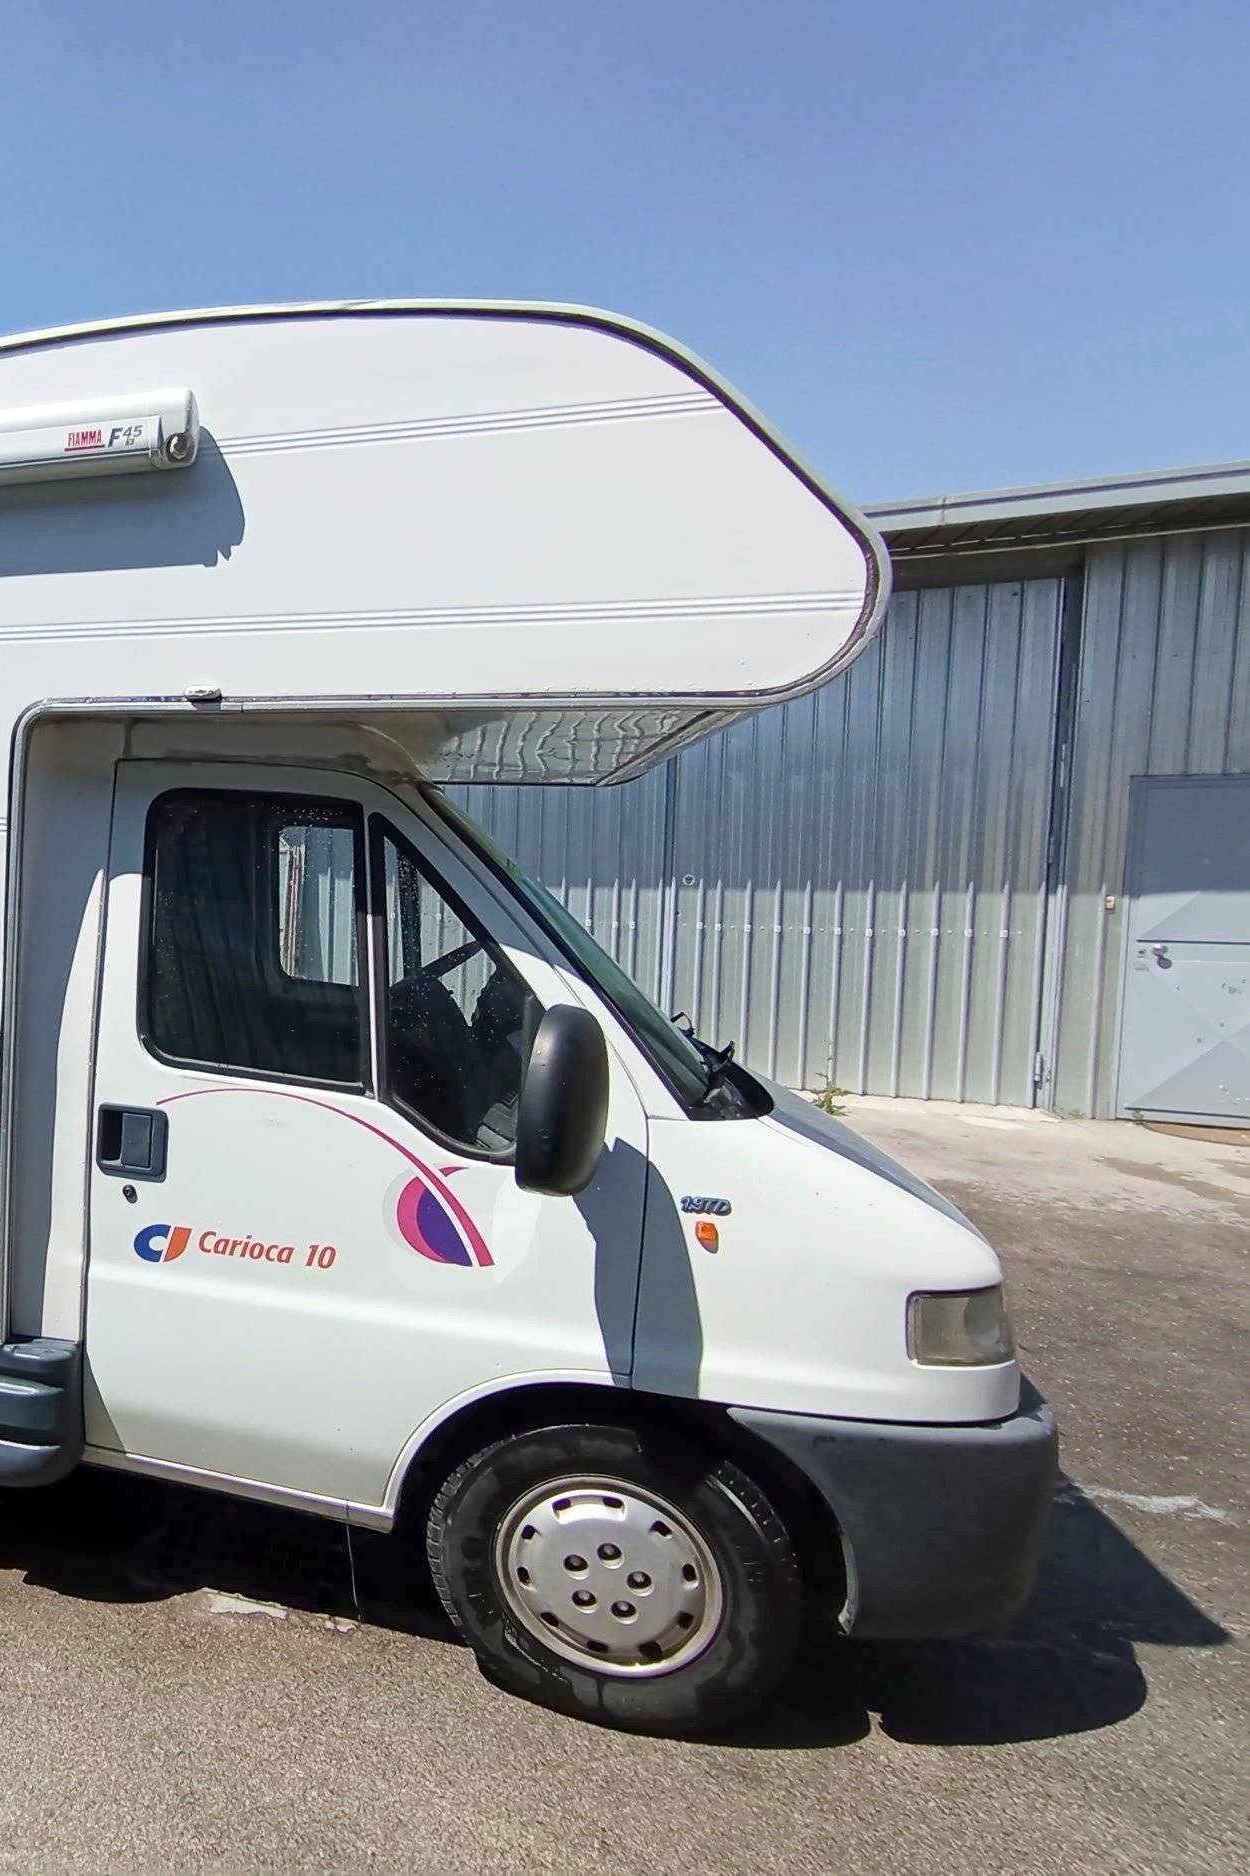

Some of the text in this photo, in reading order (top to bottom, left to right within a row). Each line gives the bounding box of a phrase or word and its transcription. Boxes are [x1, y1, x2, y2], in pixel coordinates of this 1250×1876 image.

[67, 430, 102, 447] FIAMMA
[198, 1231, 295, 1264] Carioca
[305, 1244, 337, 1269] 10
